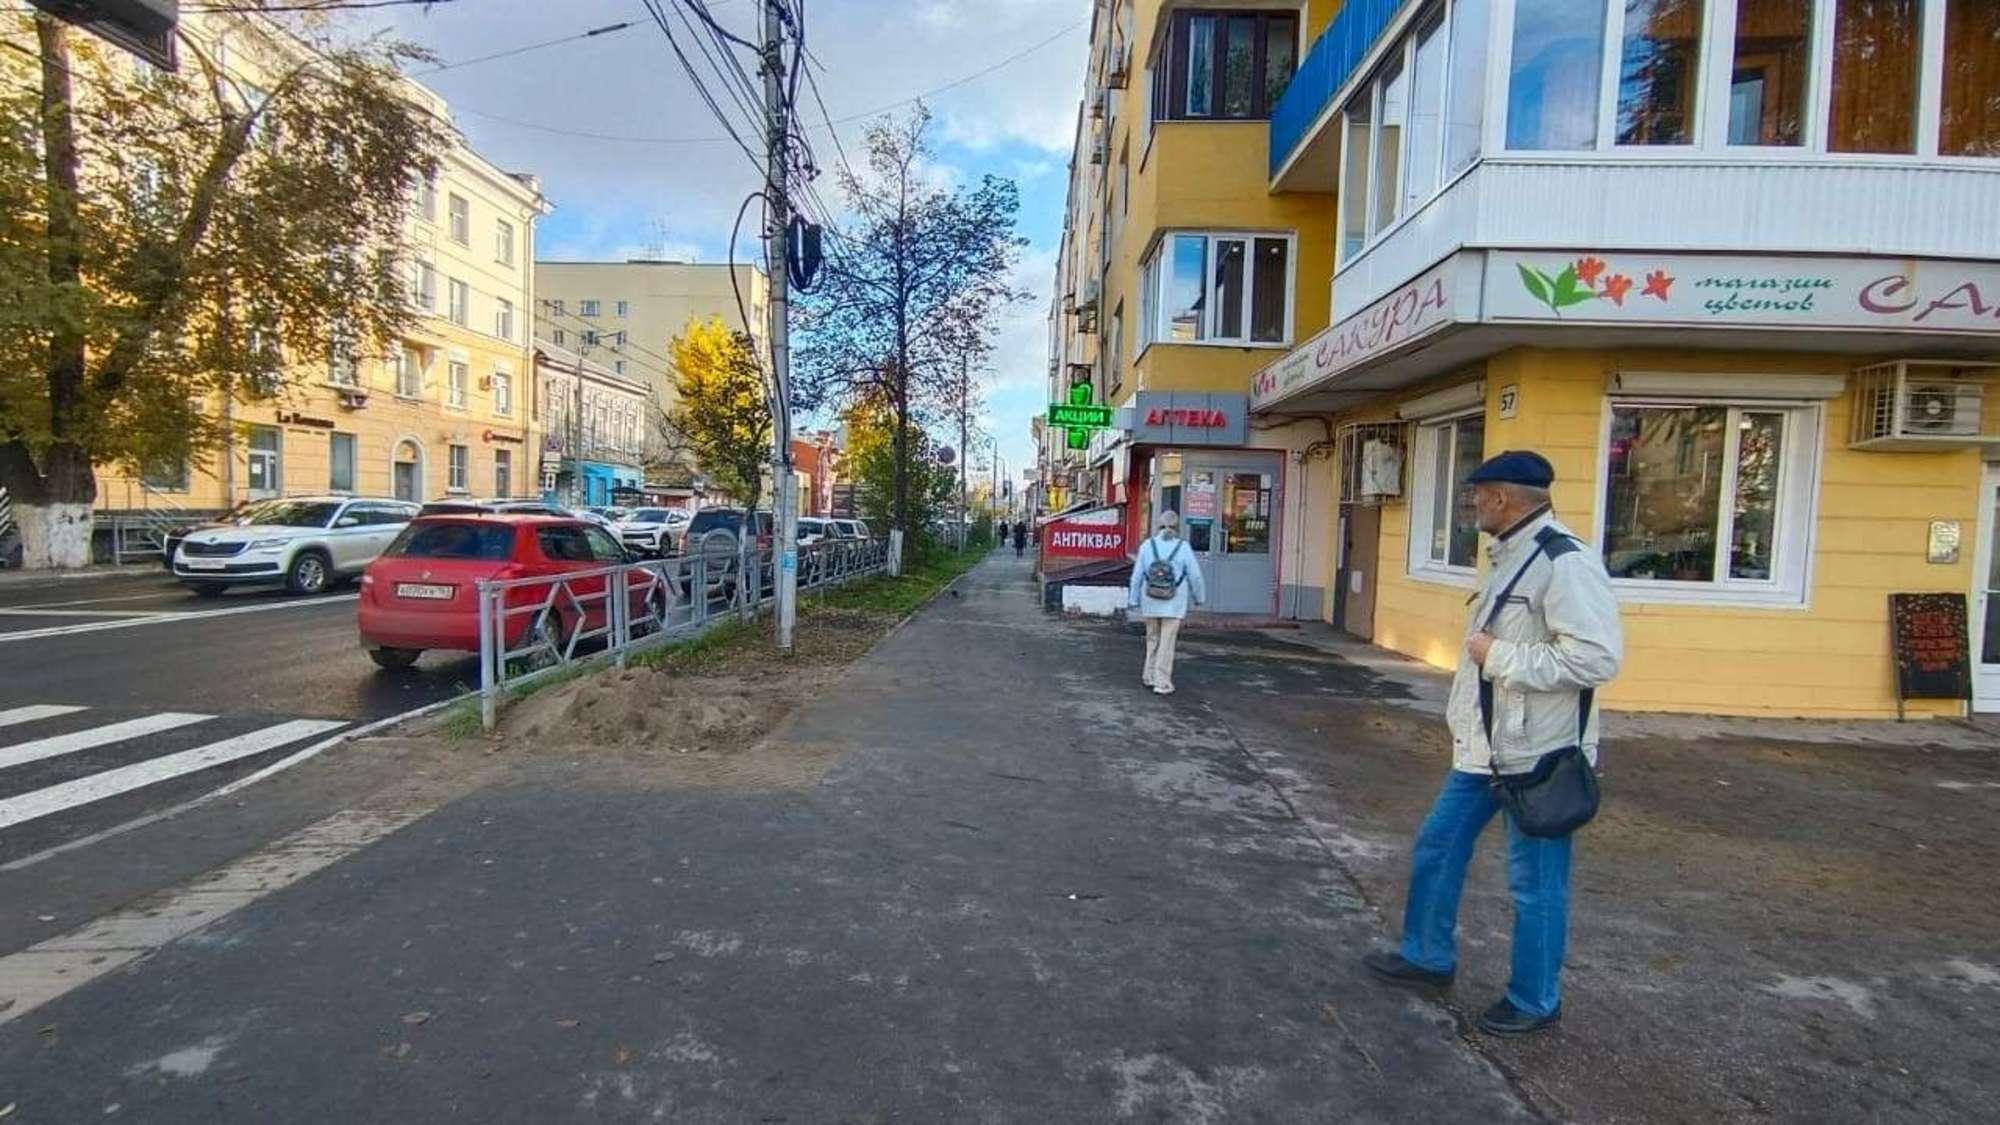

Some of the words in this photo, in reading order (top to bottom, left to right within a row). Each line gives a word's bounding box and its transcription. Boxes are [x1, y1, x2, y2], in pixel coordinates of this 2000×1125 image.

[1695, 277, 1834, 294] магазин
[1704, 292, 1815, 315] цветов
[1859, 274, 2000, 322] СА
[1315, 278, 1447, 369] САКУРА
[1501, 391, 1515, 411] 57
[1054, 409, 1105, 425] АКЦИИ
[1144, 409, 1227, 429] АПТЕКА
[1052, 531, 1122, 549] АНТИКВАР
